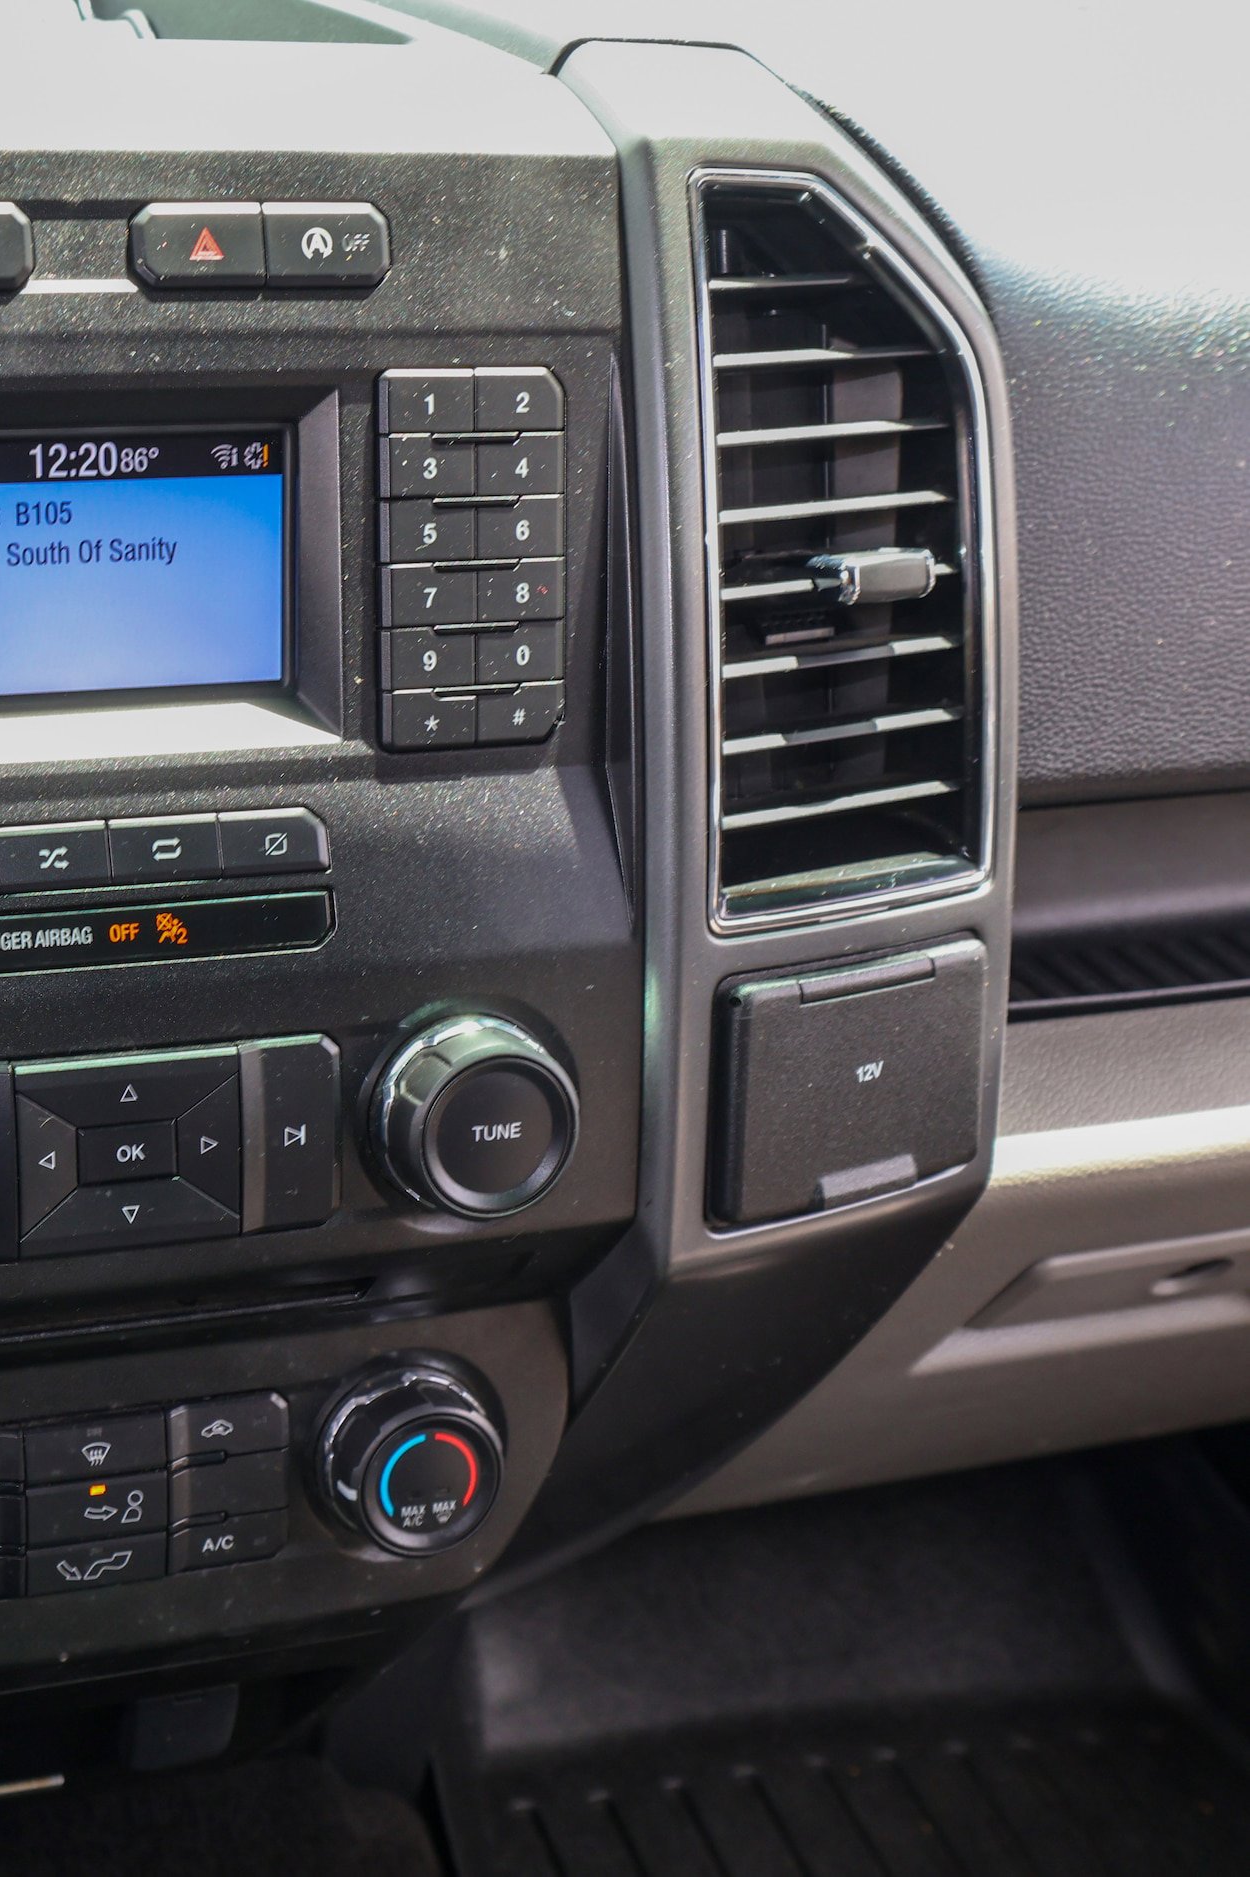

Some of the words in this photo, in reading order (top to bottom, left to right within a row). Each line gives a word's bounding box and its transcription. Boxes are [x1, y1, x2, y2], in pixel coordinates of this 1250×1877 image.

[424, 393, 435, 415] 1
[515, 391, 530, 414] 2
[28, 441, 118, 479] 12:20
[422, 457, 438, 480] 3
[514, 457, 530, 479] 4
[15, 500, 73, 527] B105
[422, 522, 438, 545] 5
[515, 519, 530, 542] 6
[6, 539, 71, 567] South
[78, 538, 103, 563] Of
[109, 535, 178, 565] Sanity
[423, 586, 438, 609] 7
[515, 582, 531, 604] 8
[422, 650, 438, 672] 9
[515, 645, 531, 667] 0
[33, 925, 94, 949] AIRBAG
[108, 922, 140, 944] OFF
[856, 1060, 885, 1084] 12V
[471, 1121, 522, 1142] TUNE
[116, 1143, 146, 1163] OK
[401, 1504, 426, 1517] MAX
[432, 1500, 457, 1514] MAX
[403, 1516, 424, 1528] A/C
[202, 1534, 235, 1554] A/C
